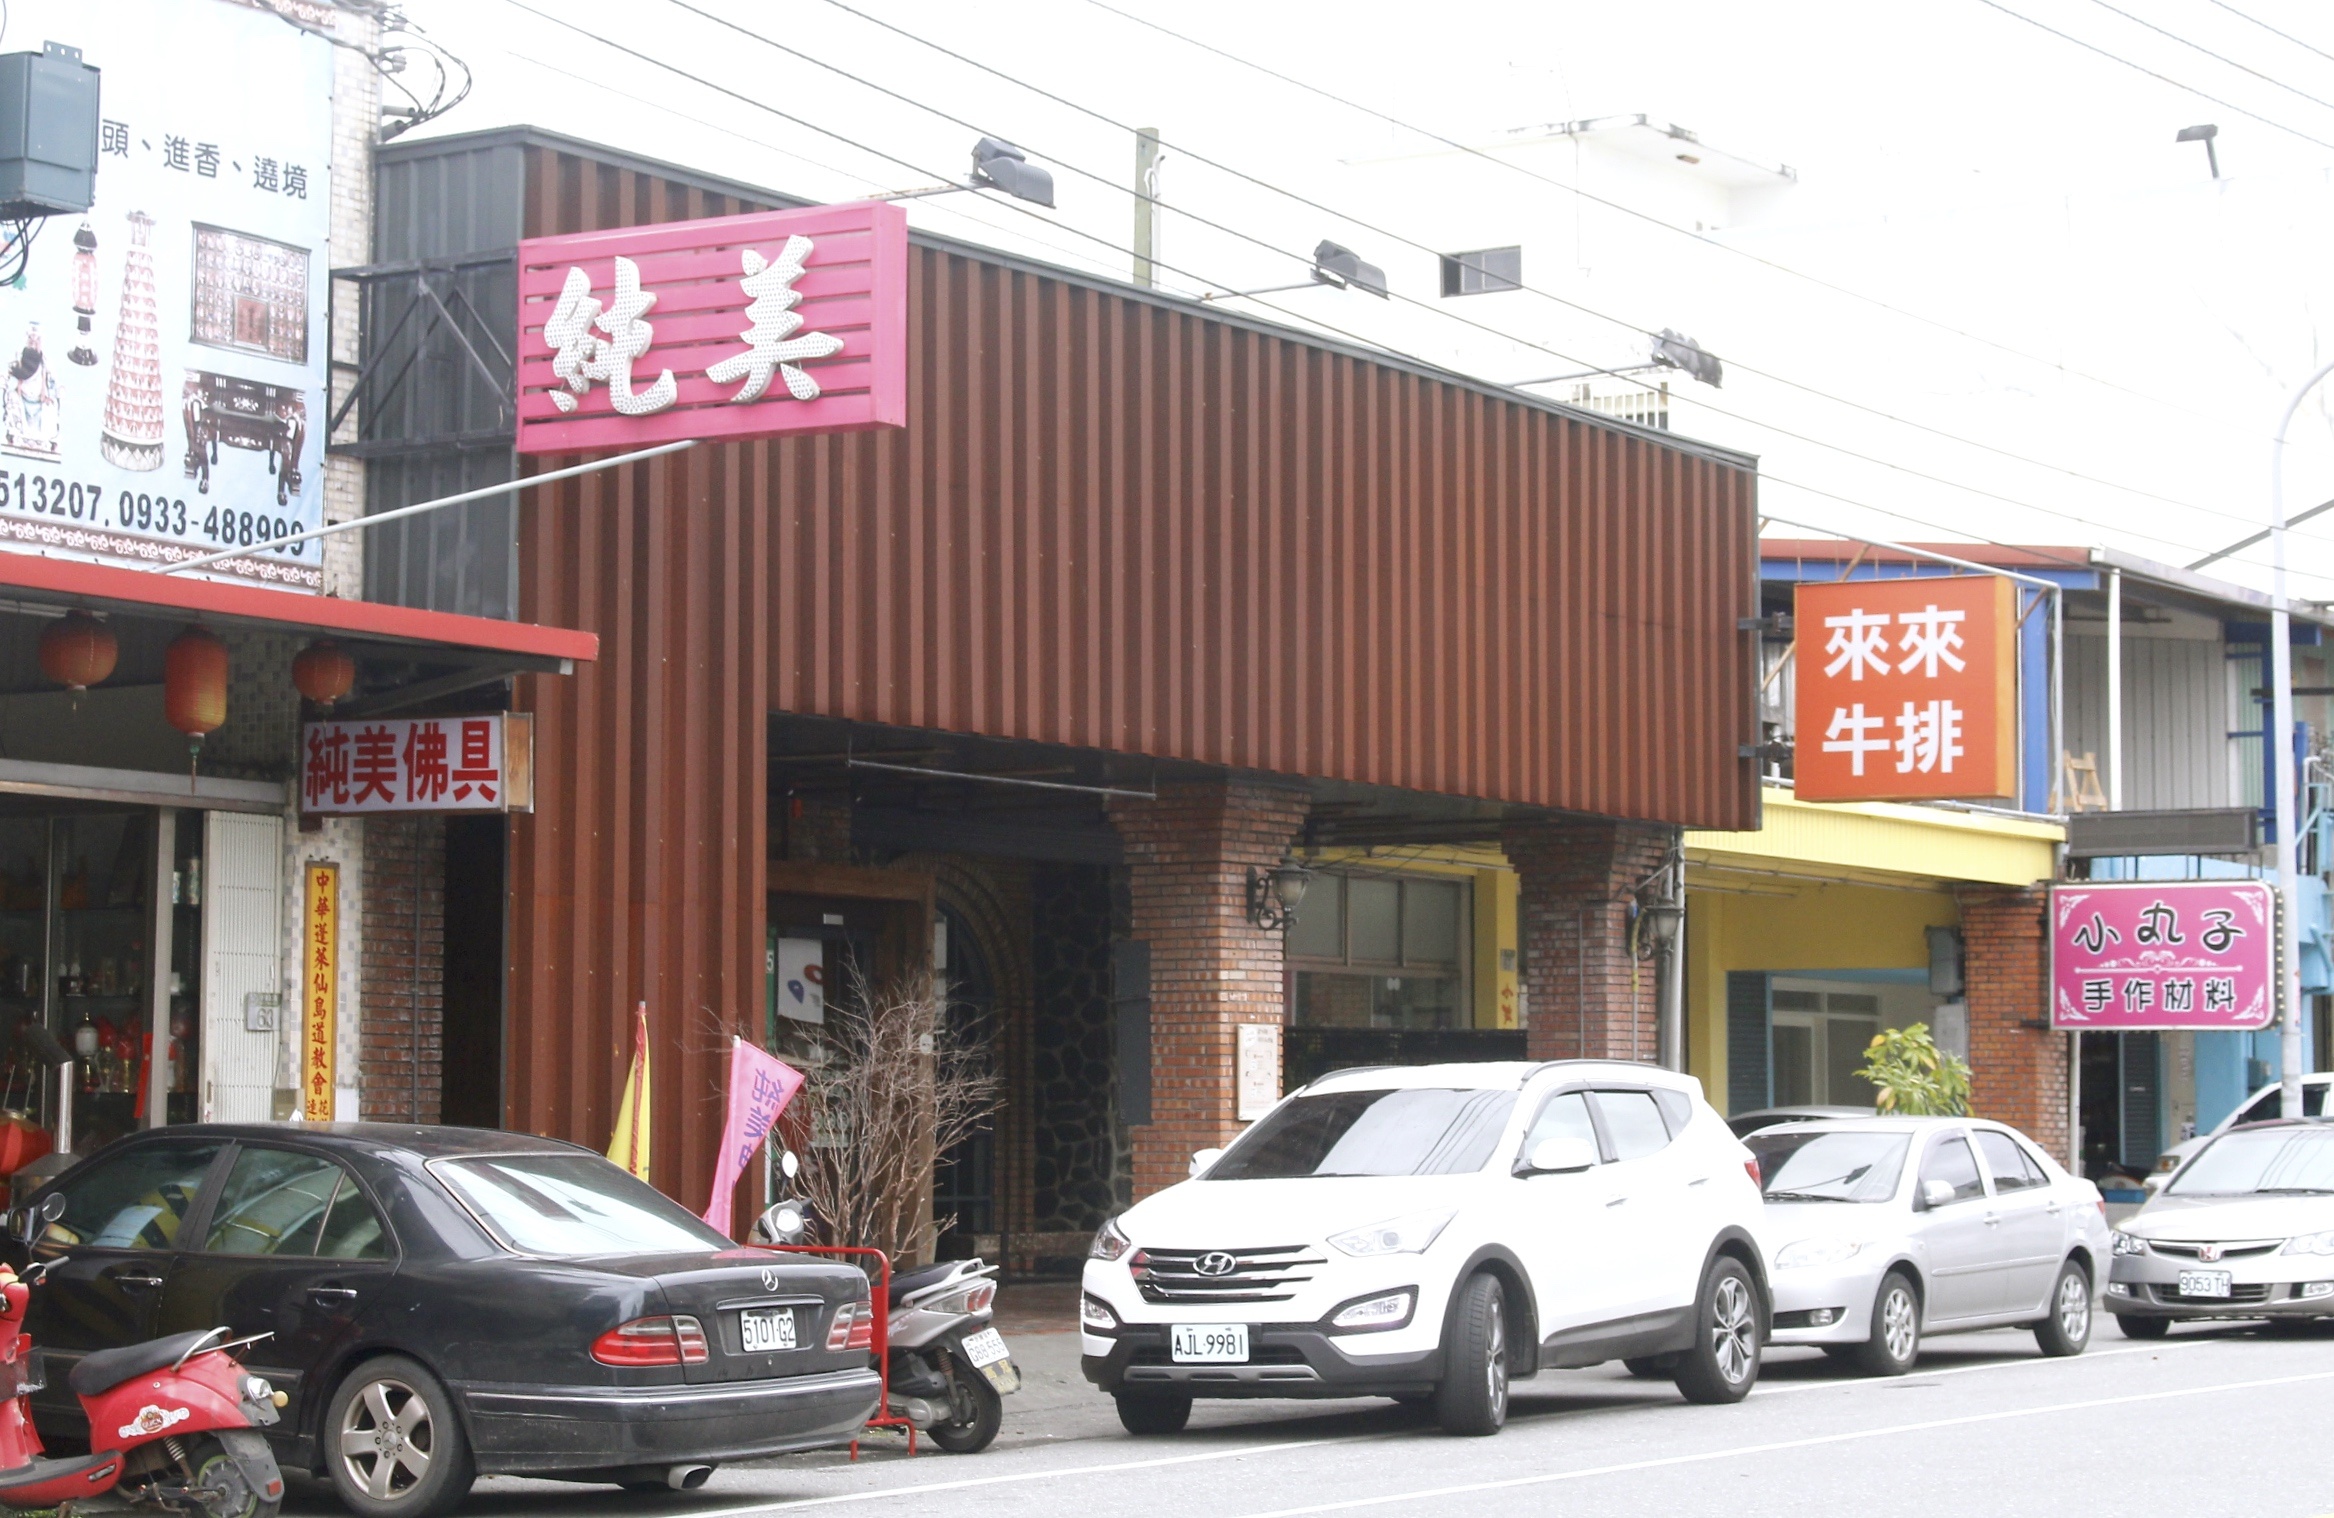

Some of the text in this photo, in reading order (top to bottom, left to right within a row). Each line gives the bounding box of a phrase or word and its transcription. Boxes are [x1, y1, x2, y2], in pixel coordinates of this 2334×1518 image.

[544, 234, 844, 416] 純美
[1824, 605, 1966, 681] 來來
[306, 720, 498, 806] 純美佛具
[1822, 700, 1964, 776] 牛排
[2072, 901, 2246, 953] 小丸子
[2083, 978, 2236, 1012] 手作材料
